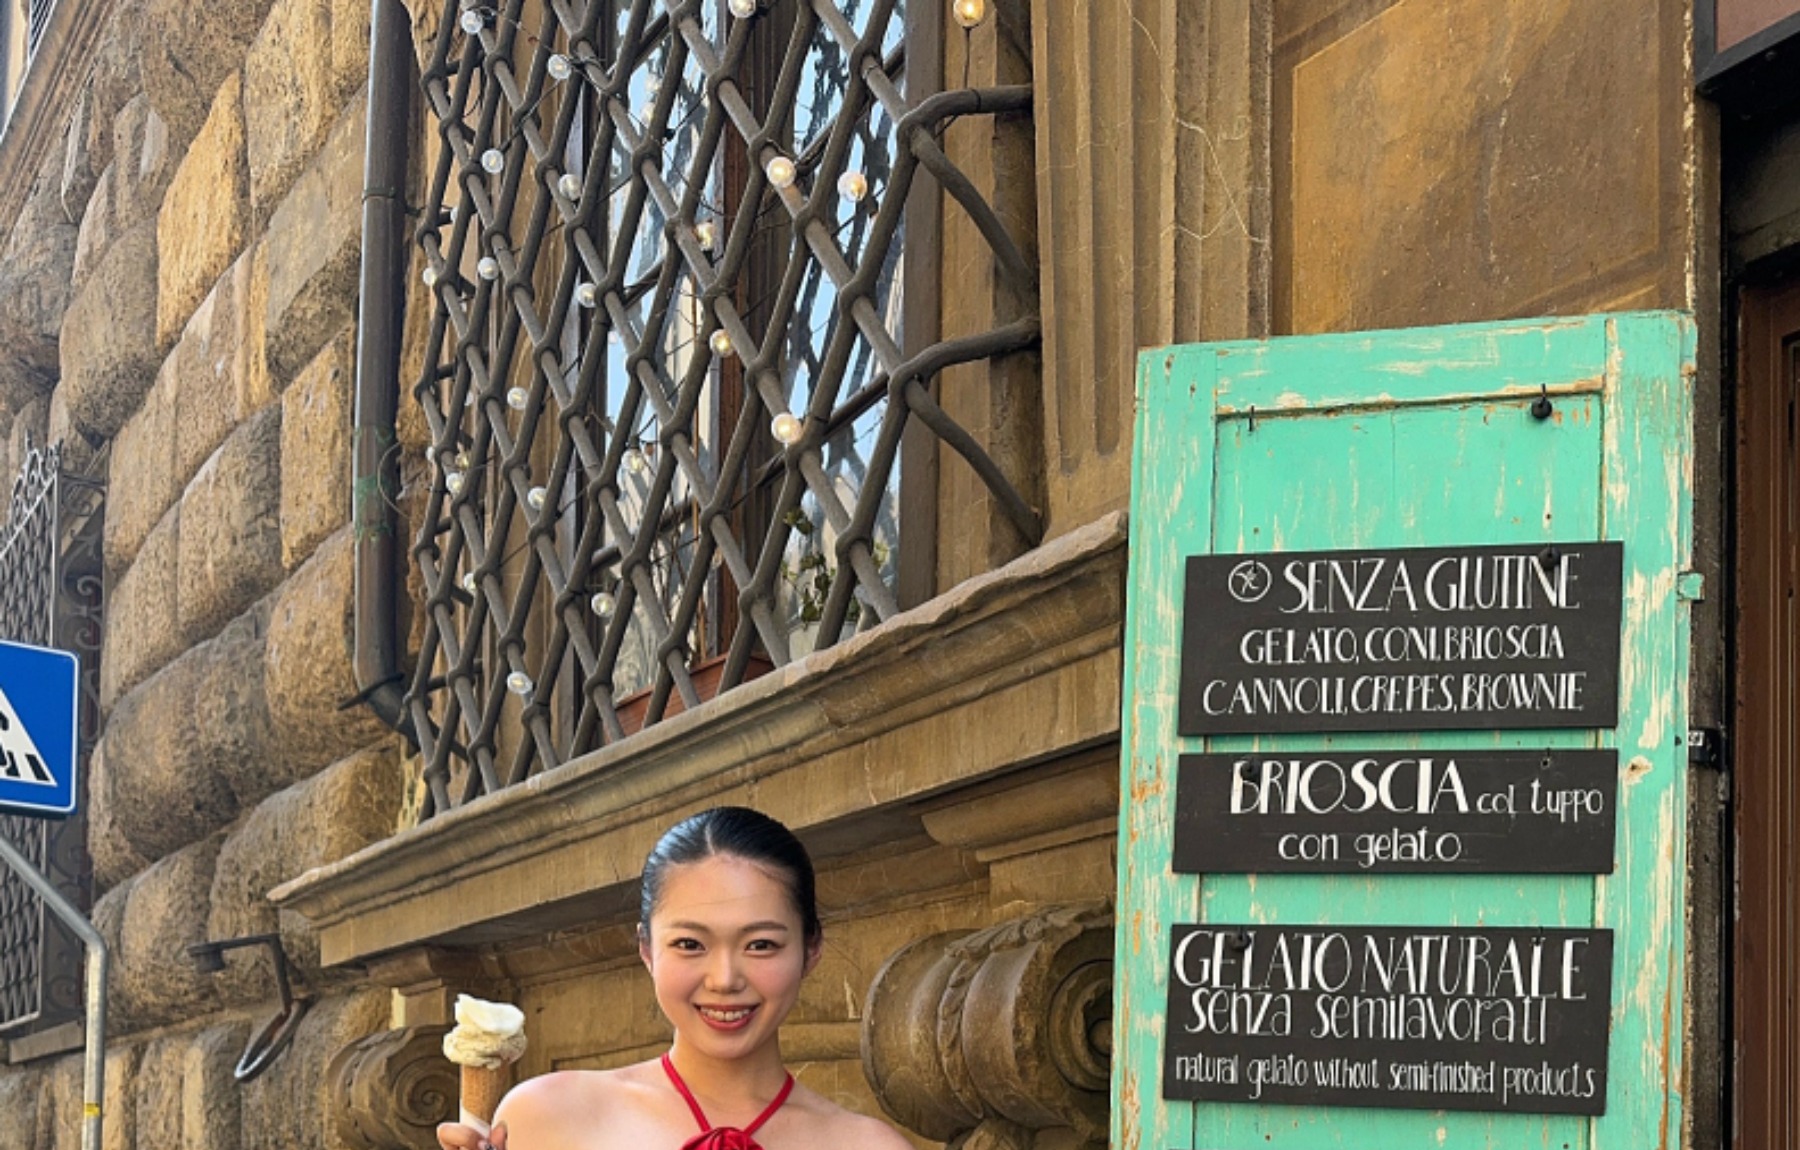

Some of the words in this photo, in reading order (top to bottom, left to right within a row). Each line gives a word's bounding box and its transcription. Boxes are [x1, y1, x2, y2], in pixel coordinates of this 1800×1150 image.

[1279, 557, 1420, 613] SENZA
[1424, 553, 1580, 611] GLUTINE
[1239, 627, 1359, 665] GELATO,
[1444, 624, 1565, 661] BRIOSCIA
[1351, 674, 1458, 713] CREPES,
[1460, 671, 1586, 712] BROWNIE
[1230, 759, 1470, 814] BRIOSCIA
[1476, 784, 1516, 816] col
[1530, 777, 1604, 822] tuppo
[1278, 833, 1339, 861] con
[1354, 825, 1462, 868] gelato
[1174, 930, 1352, 993] GELATO
[1361, 935, 1590, 1000] NATURALE
[1184, 988, 1292, 1036] senza
[1310, 993, 1547, 1046] semilavorati
[1175, 1052, 1239, 1084] natural
[1246, 1053, 1309, 1099] gelato
[1314, 1058, 1379, 1089] without
[1388, 1060, 1496, 1094] semi-finished
[1503, 1060, 1596, 1106] products
